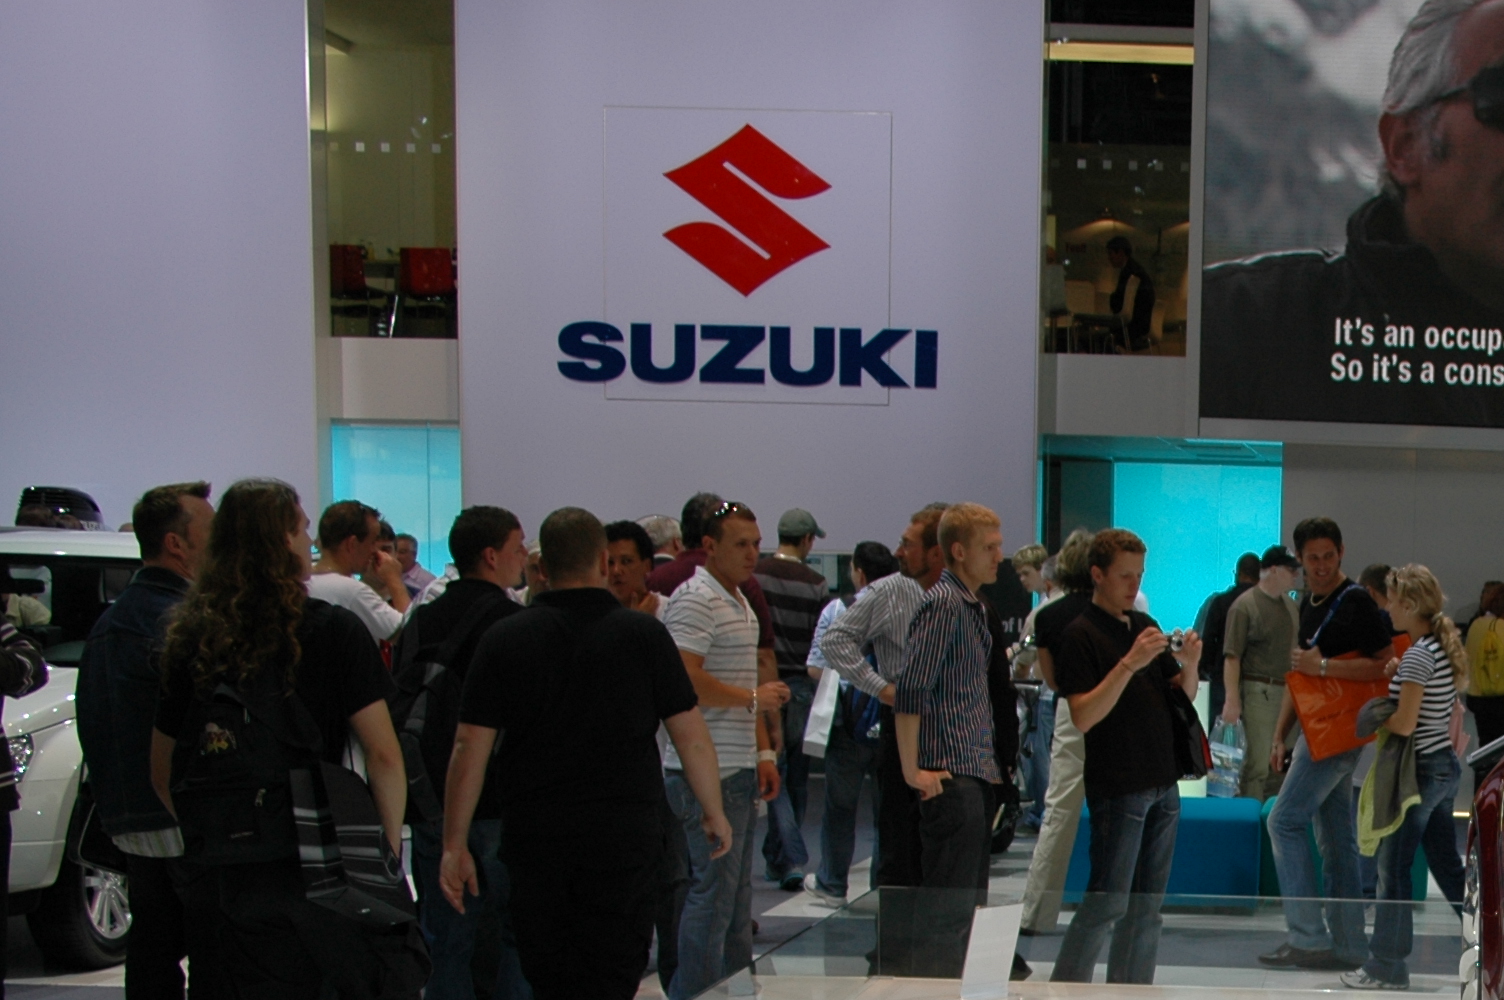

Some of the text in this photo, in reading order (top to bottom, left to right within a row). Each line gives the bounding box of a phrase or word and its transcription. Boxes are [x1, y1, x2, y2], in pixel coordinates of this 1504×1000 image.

[1334, 317, 1375, 347] It's
[1384, 323, 1415, 348] an
[556, 320, 939, 390] SUZUKI
[1330, 351, 1364, 382] So
[1372, 353, 1413, 384] it's
[1420, 360, 1435, 384] a
